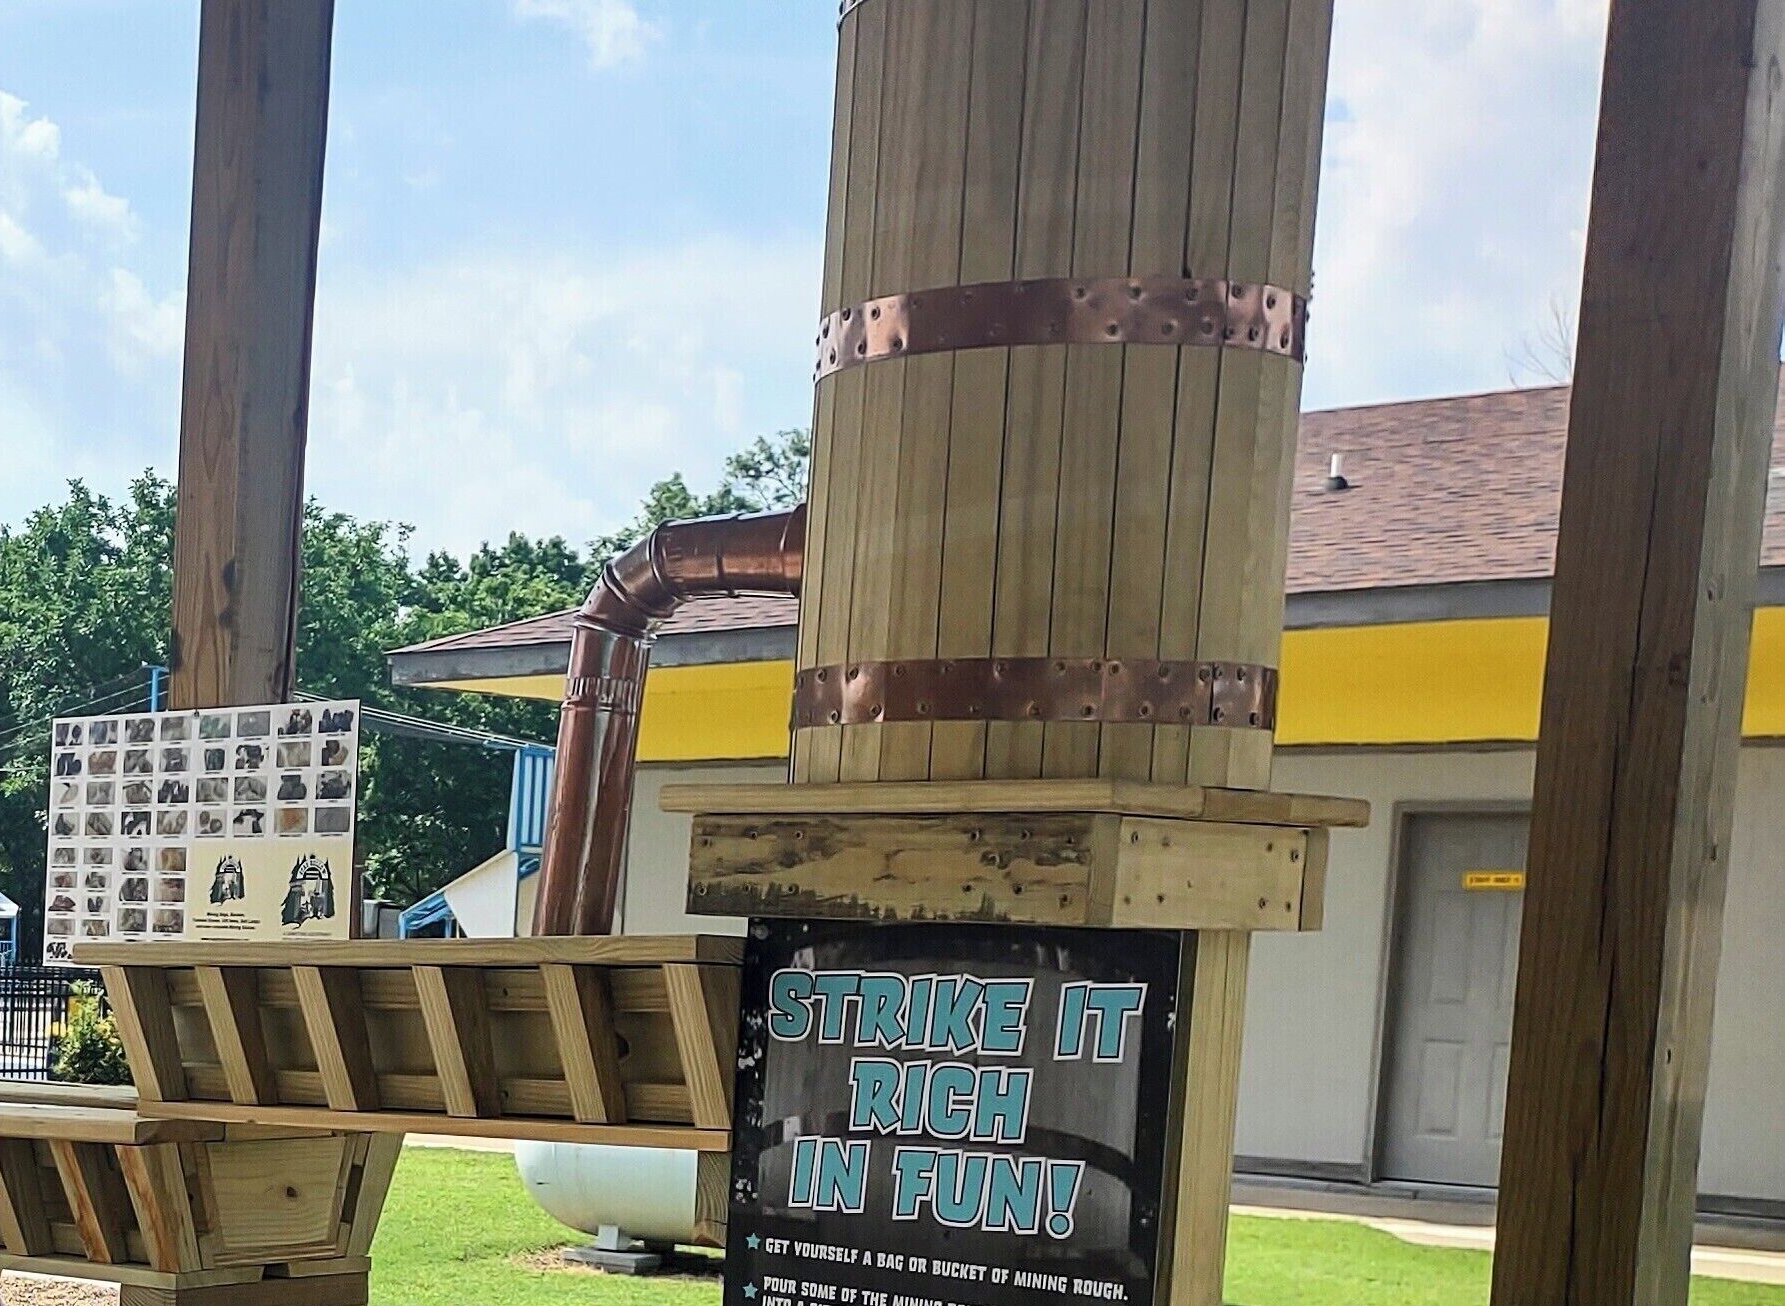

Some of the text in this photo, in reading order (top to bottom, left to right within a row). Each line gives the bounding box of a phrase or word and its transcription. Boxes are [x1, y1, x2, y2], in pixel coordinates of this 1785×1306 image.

[767, 968, 1148, 1063] STRIKE IT
[848, 1057, 1033, 1144] RICH
[788, 1136, 1085, 1239] IN FUN!
[764, 1276, 796, 1294] POUR
[801, 1282, 836, 1300] SOME
[841, 1287, 857, 1303] OF
[862, 1290, 888, 1306] THE
[765, 1238, 1128, 1301] GET YOURSELF A BAG OR BUCKET OF MINING ROUGH.
